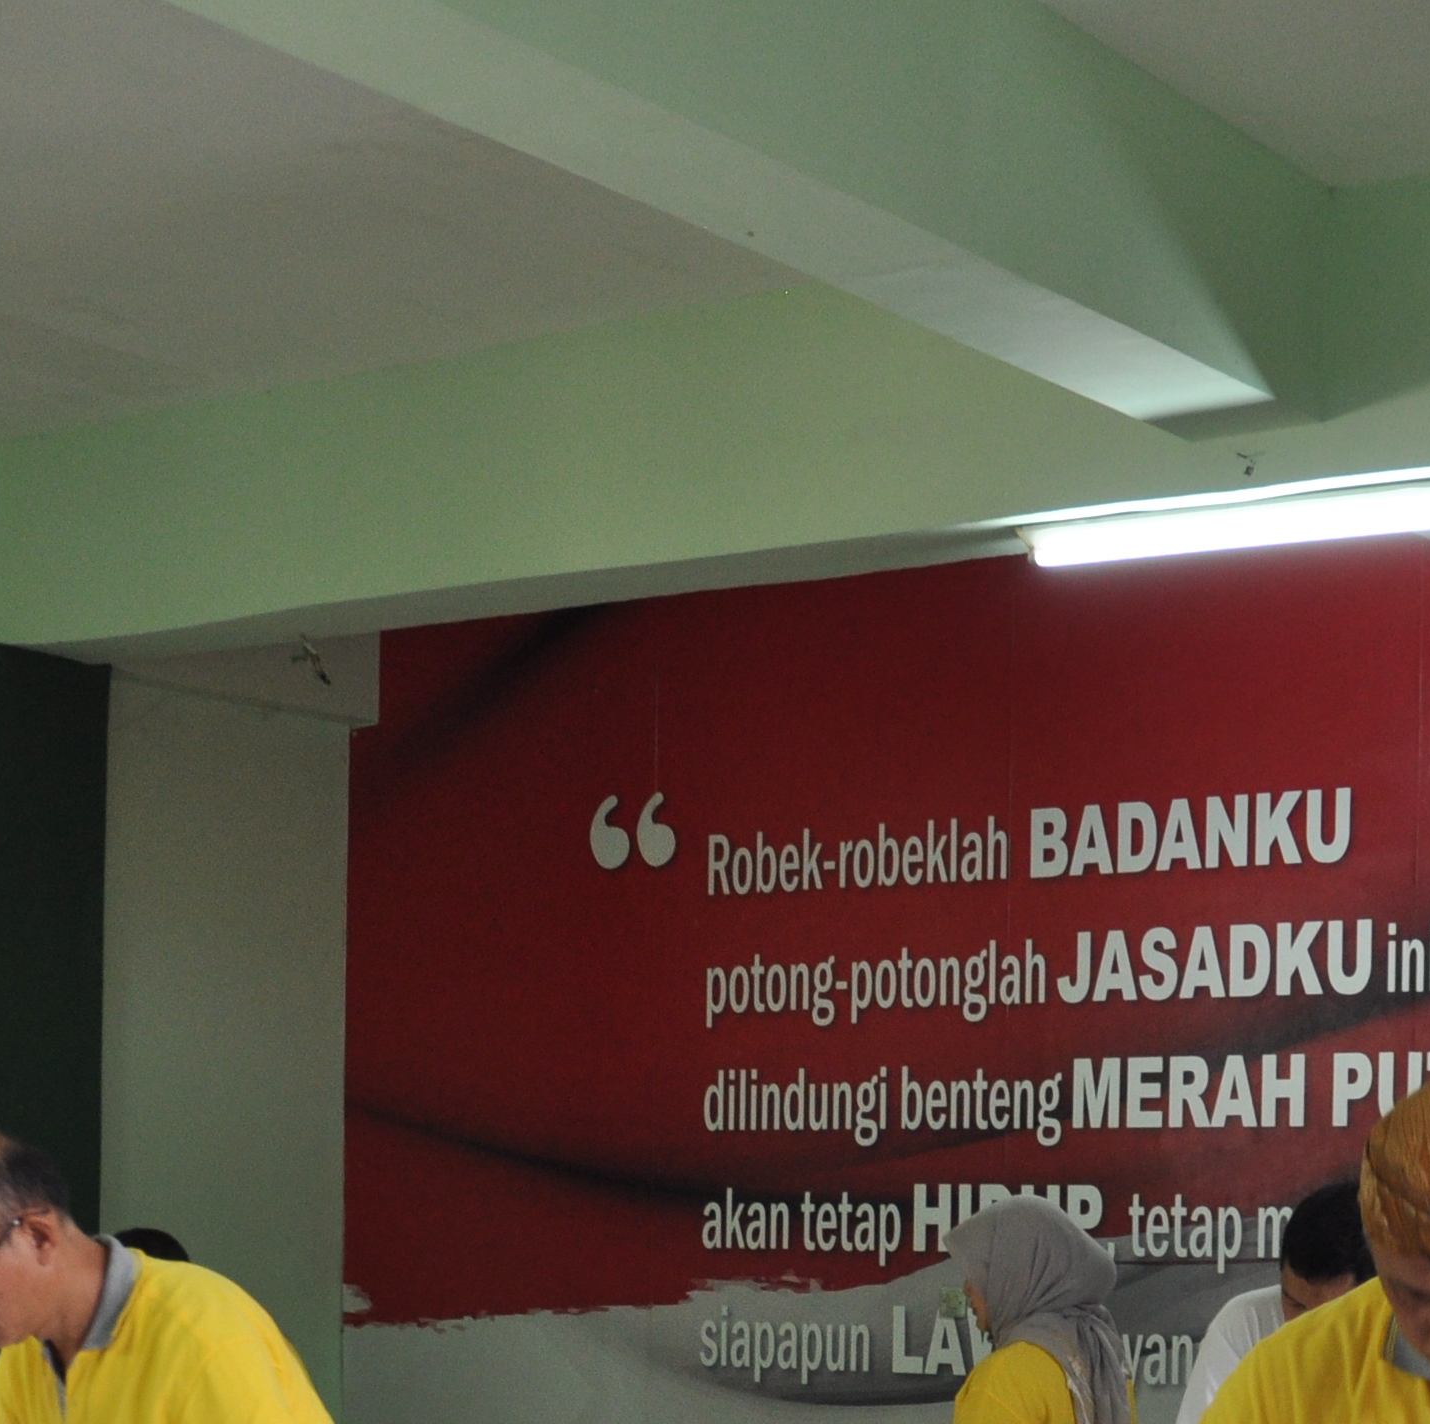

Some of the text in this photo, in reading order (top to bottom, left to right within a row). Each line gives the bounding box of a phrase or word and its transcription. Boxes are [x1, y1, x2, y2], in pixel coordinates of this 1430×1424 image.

[706, 786, 1353, 896] Robek-robeklah BADANKU
[705, 938, 1047, 1028] potong-potonglah
[1056, 919, 1374, 1004] JASADKU
[703, 1066, 889, 1147] dilindungi
[900, 1066, 1063, 1147] benteng
[1072, 1054, 1306, 1129] MERAH
[701, 1188, 790, 1252] akan
[800, 1190, 903, 1266] tetap
[1127, 1193, 1243, 1274] tetap
[699, 1306, 871, 1384] siapapun
